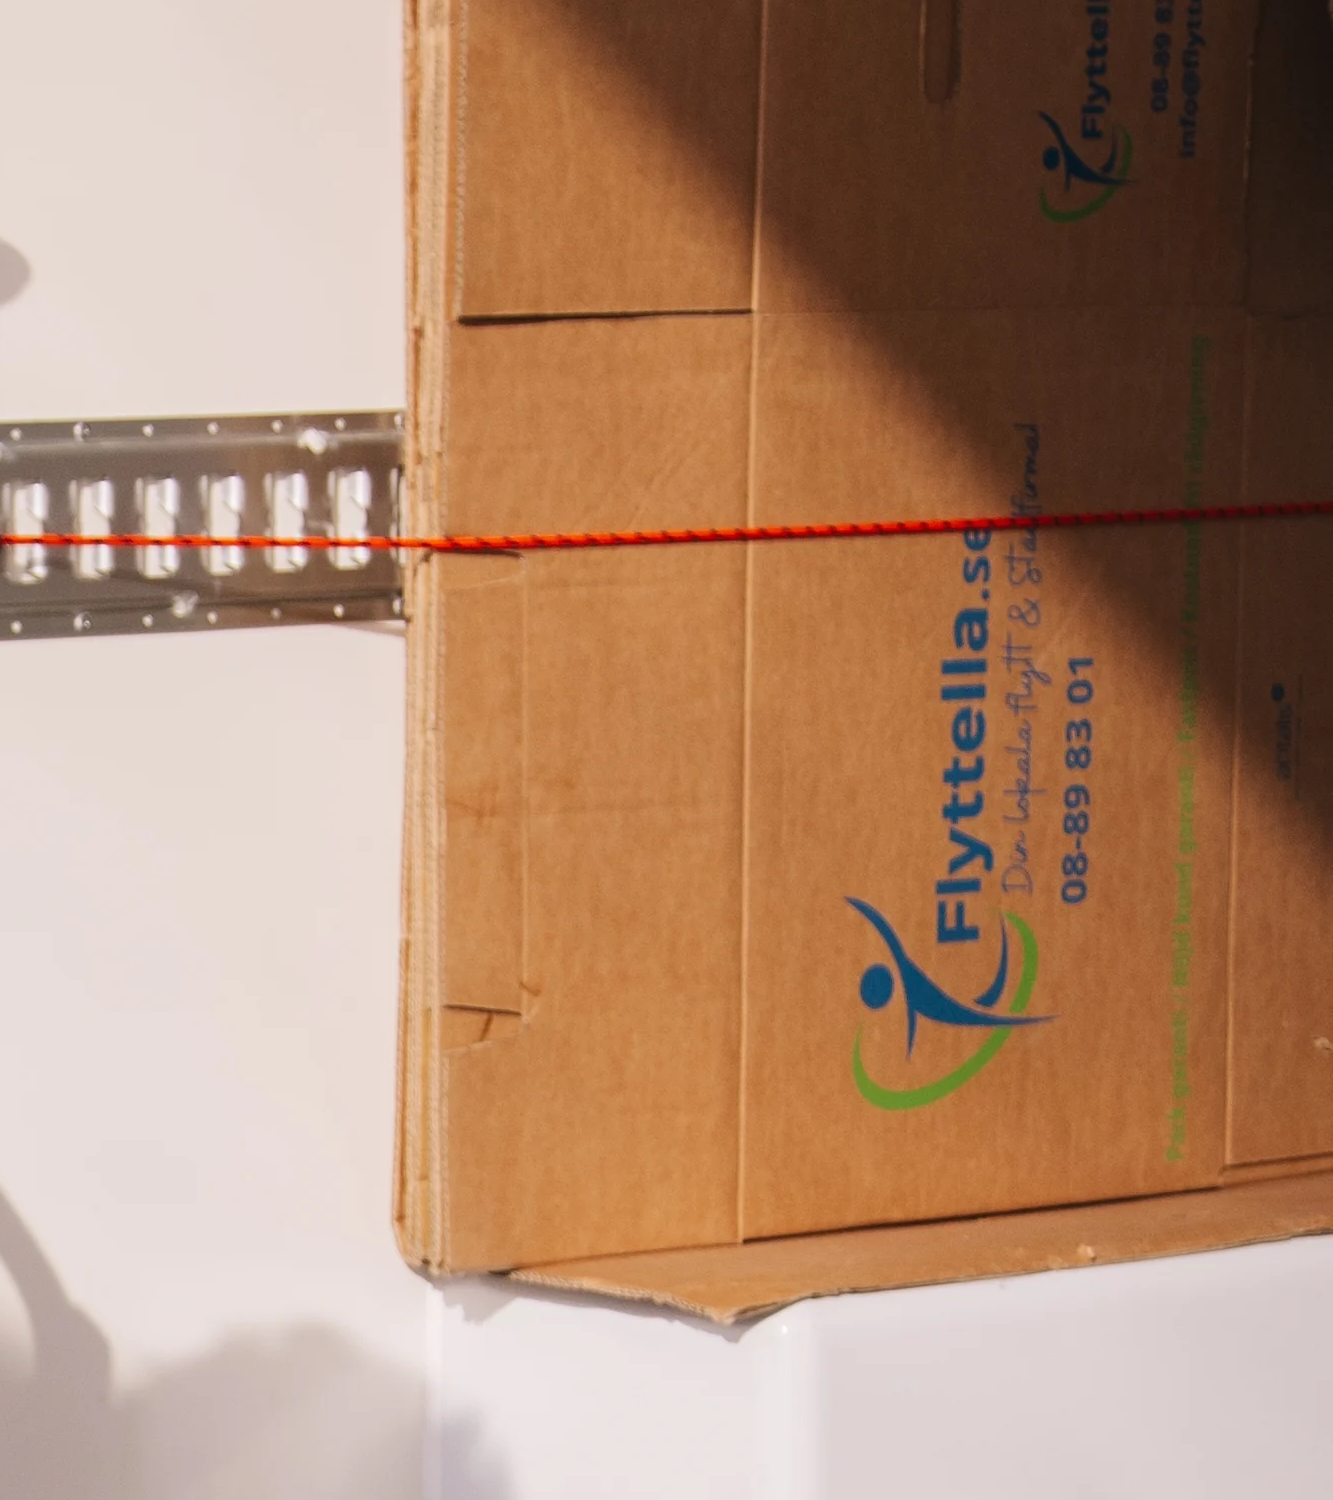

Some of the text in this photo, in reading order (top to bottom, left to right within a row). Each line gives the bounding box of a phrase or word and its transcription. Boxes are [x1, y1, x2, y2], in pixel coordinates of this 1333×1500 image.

[936, 527, 994, 945] Flyttella.se
[1008, 598, 1041, 628] &
[1060, 657, 1095, 904] 08-89 83 01
